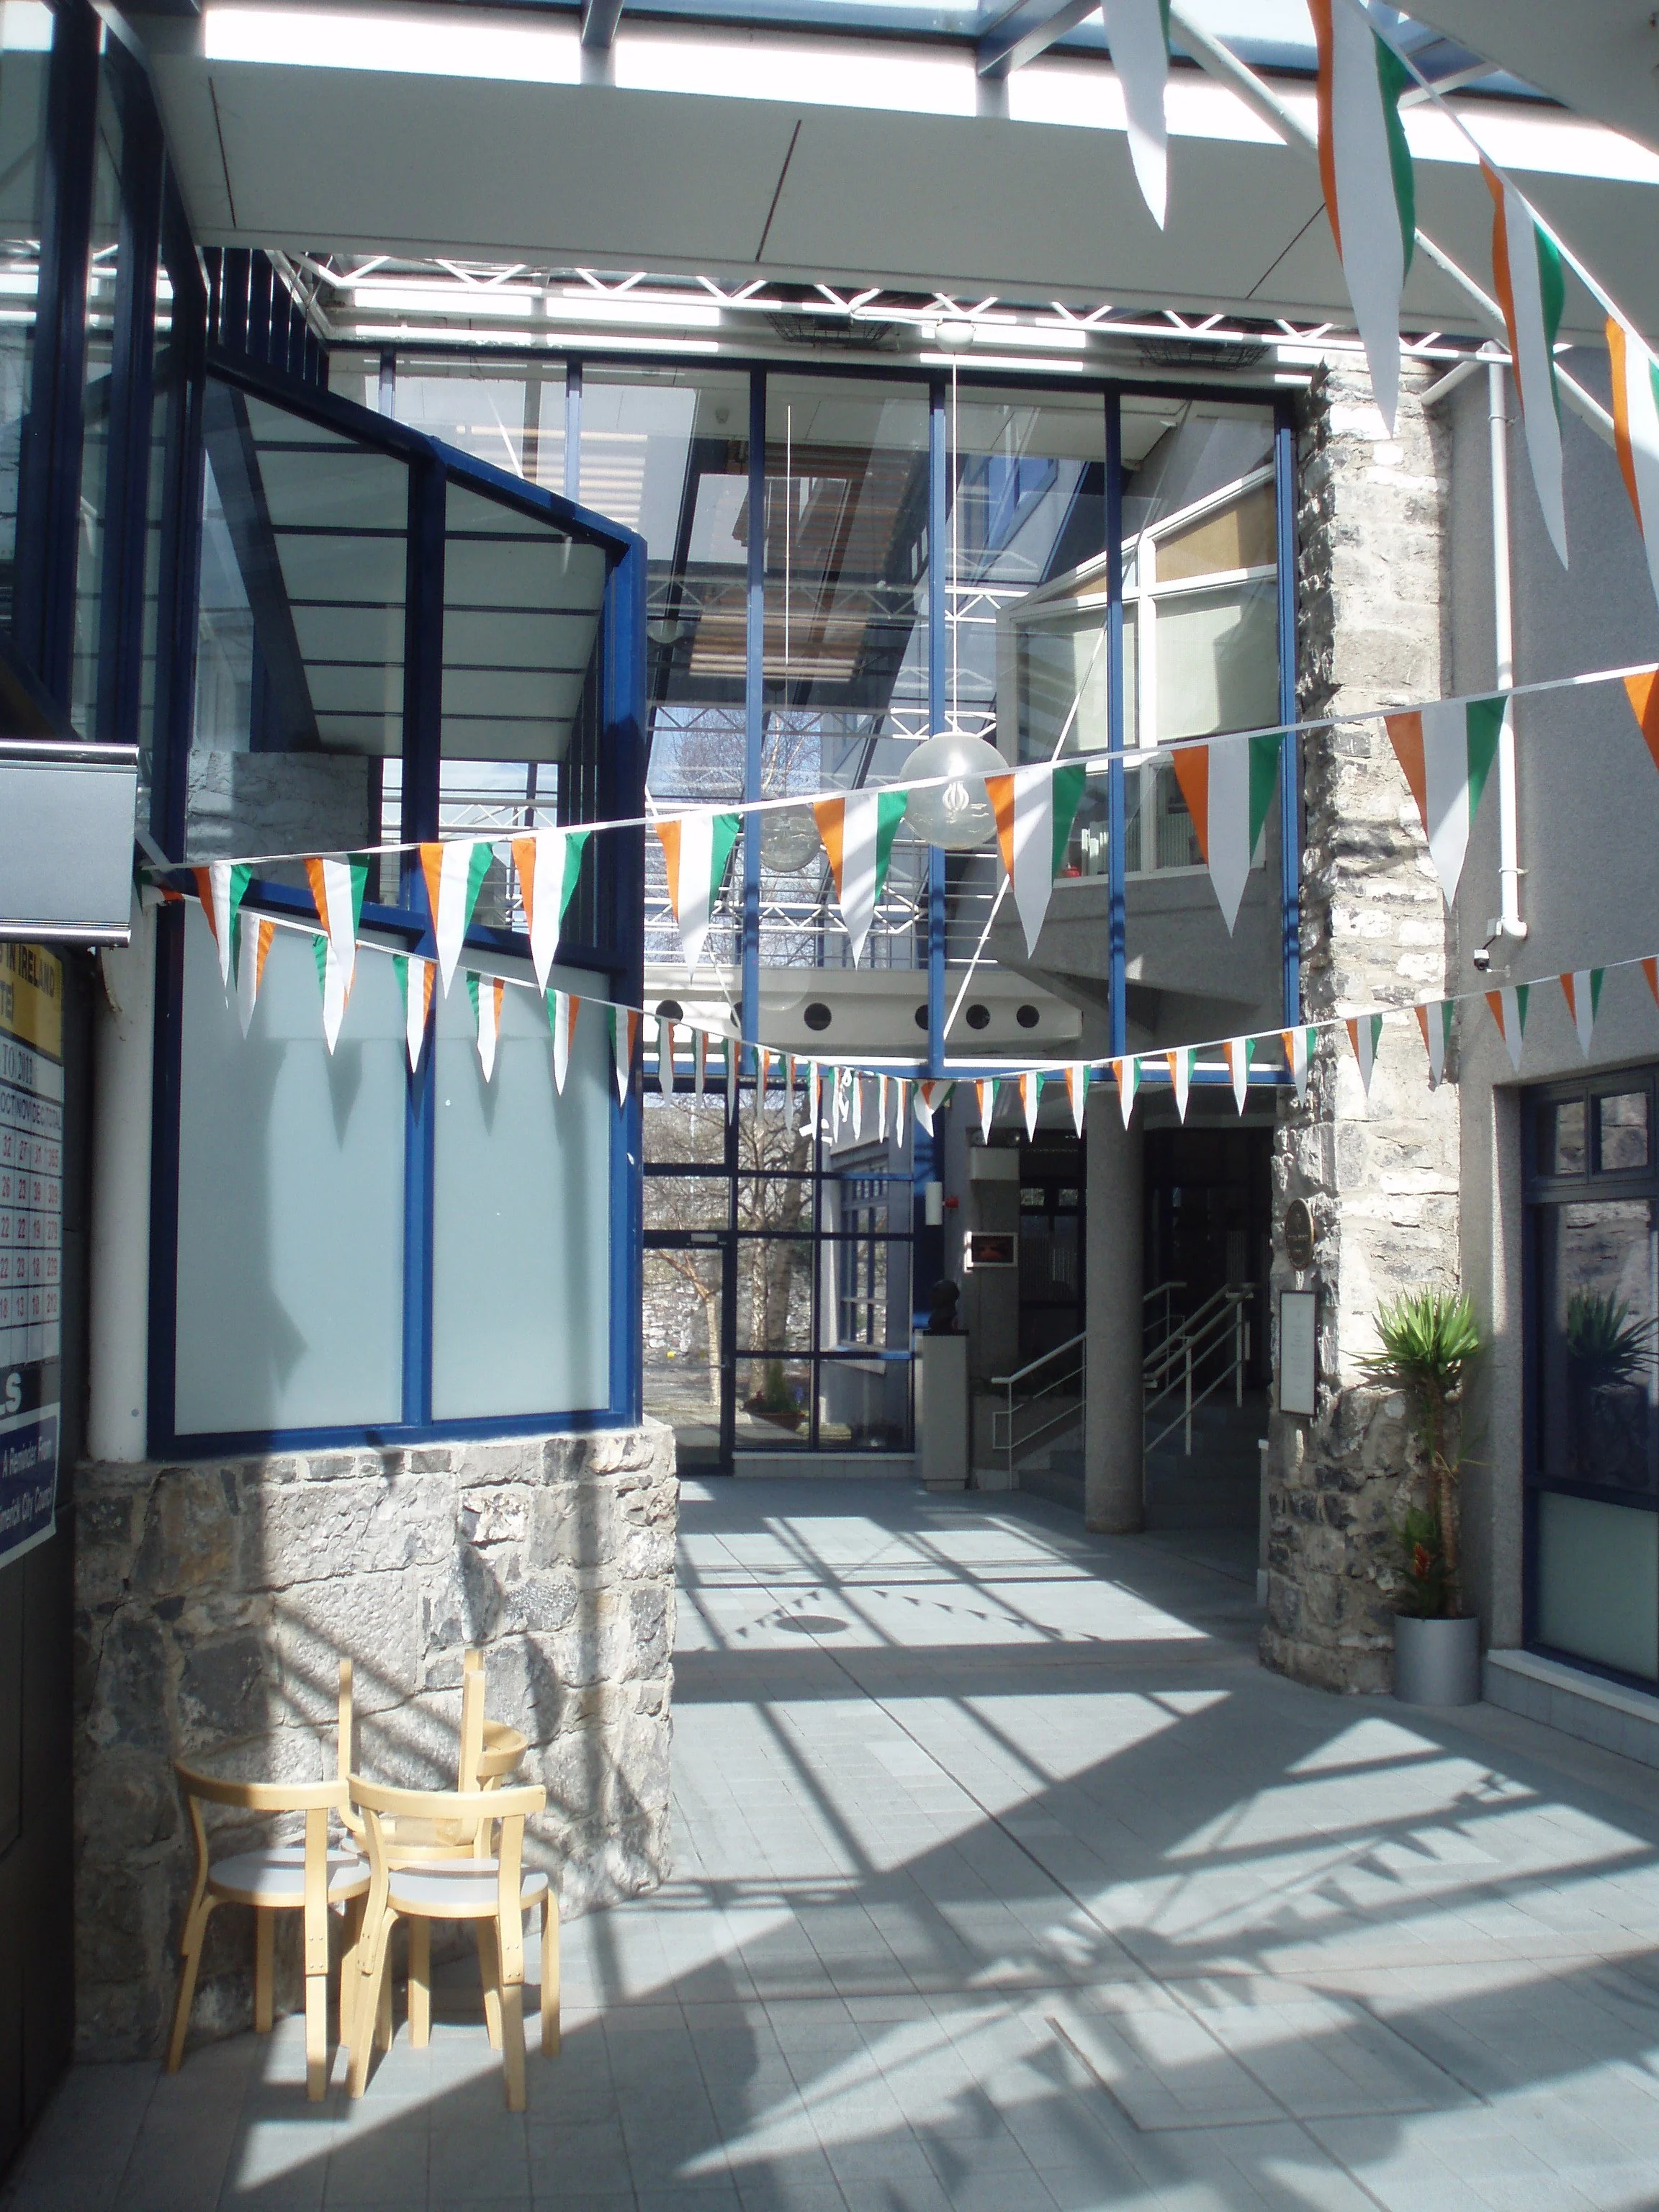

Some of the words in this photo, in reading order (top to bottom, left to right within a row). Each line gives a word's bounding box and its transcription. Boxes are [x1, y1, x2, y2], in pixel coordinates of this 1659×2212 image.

[19, 944, 55, 998] IRELAND
[3, 1043, 14, 1078] TO
[1, 1092, 15, 1115] OCT
[17, 1097, 30, 1121] NOV
